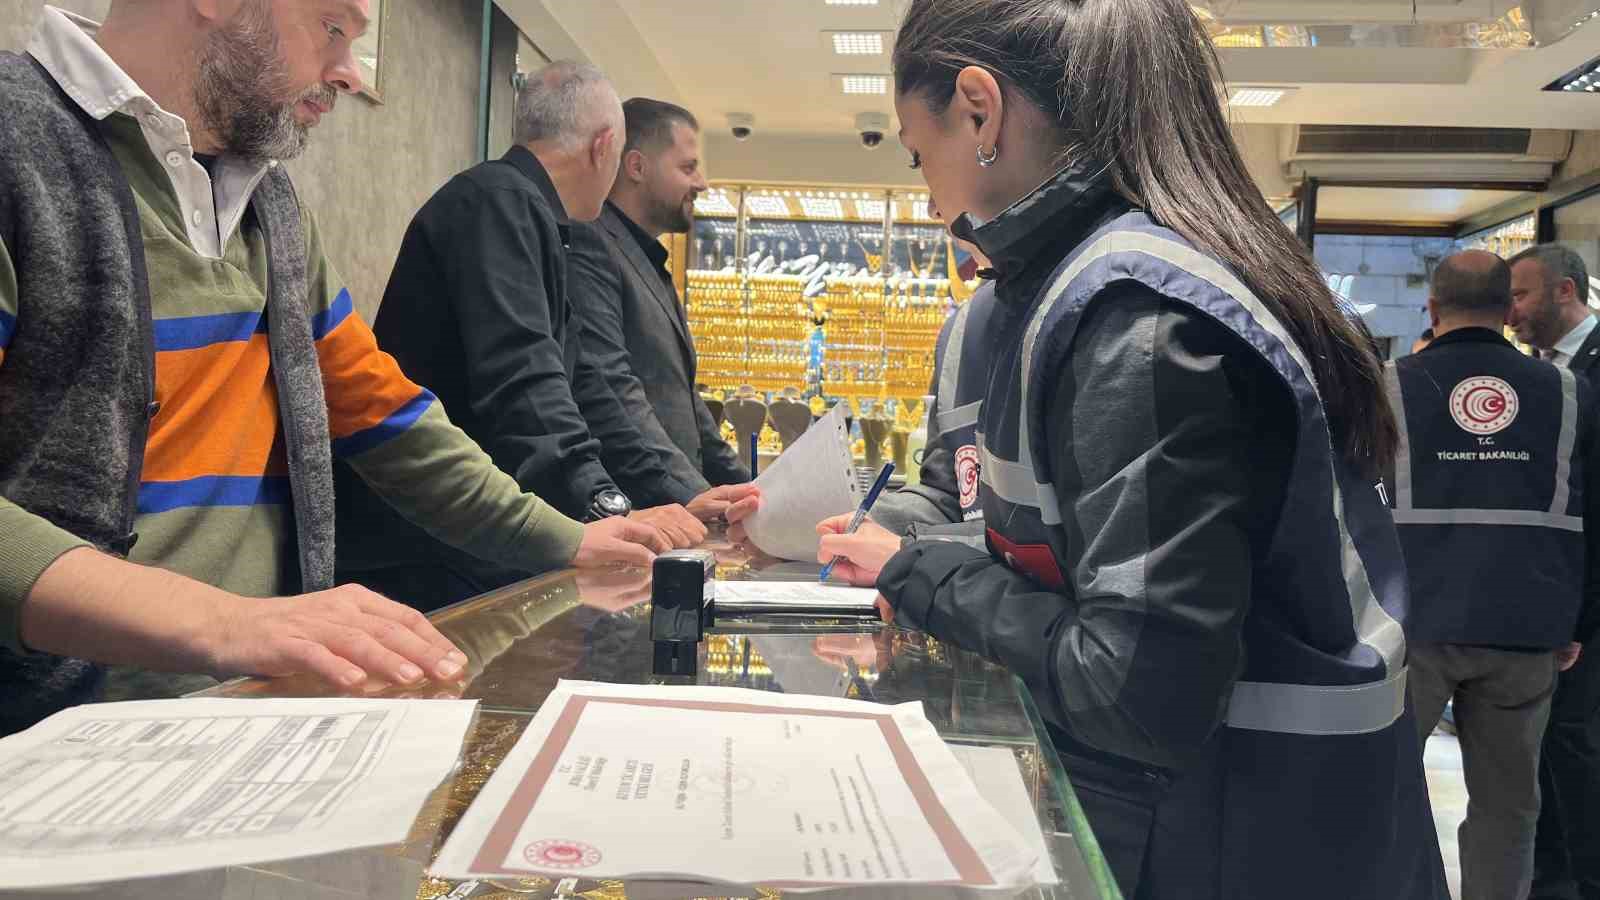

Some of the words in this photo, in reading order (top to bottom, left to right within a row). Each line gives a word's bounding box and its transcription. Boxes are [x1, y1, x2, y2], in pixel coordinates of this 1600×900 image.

[1477, 437, 1495, 445] T.C.
[1437, 450, 1477, 460] TİCARET
[1479, 450, 1530, 461] BAKANLIĞI
